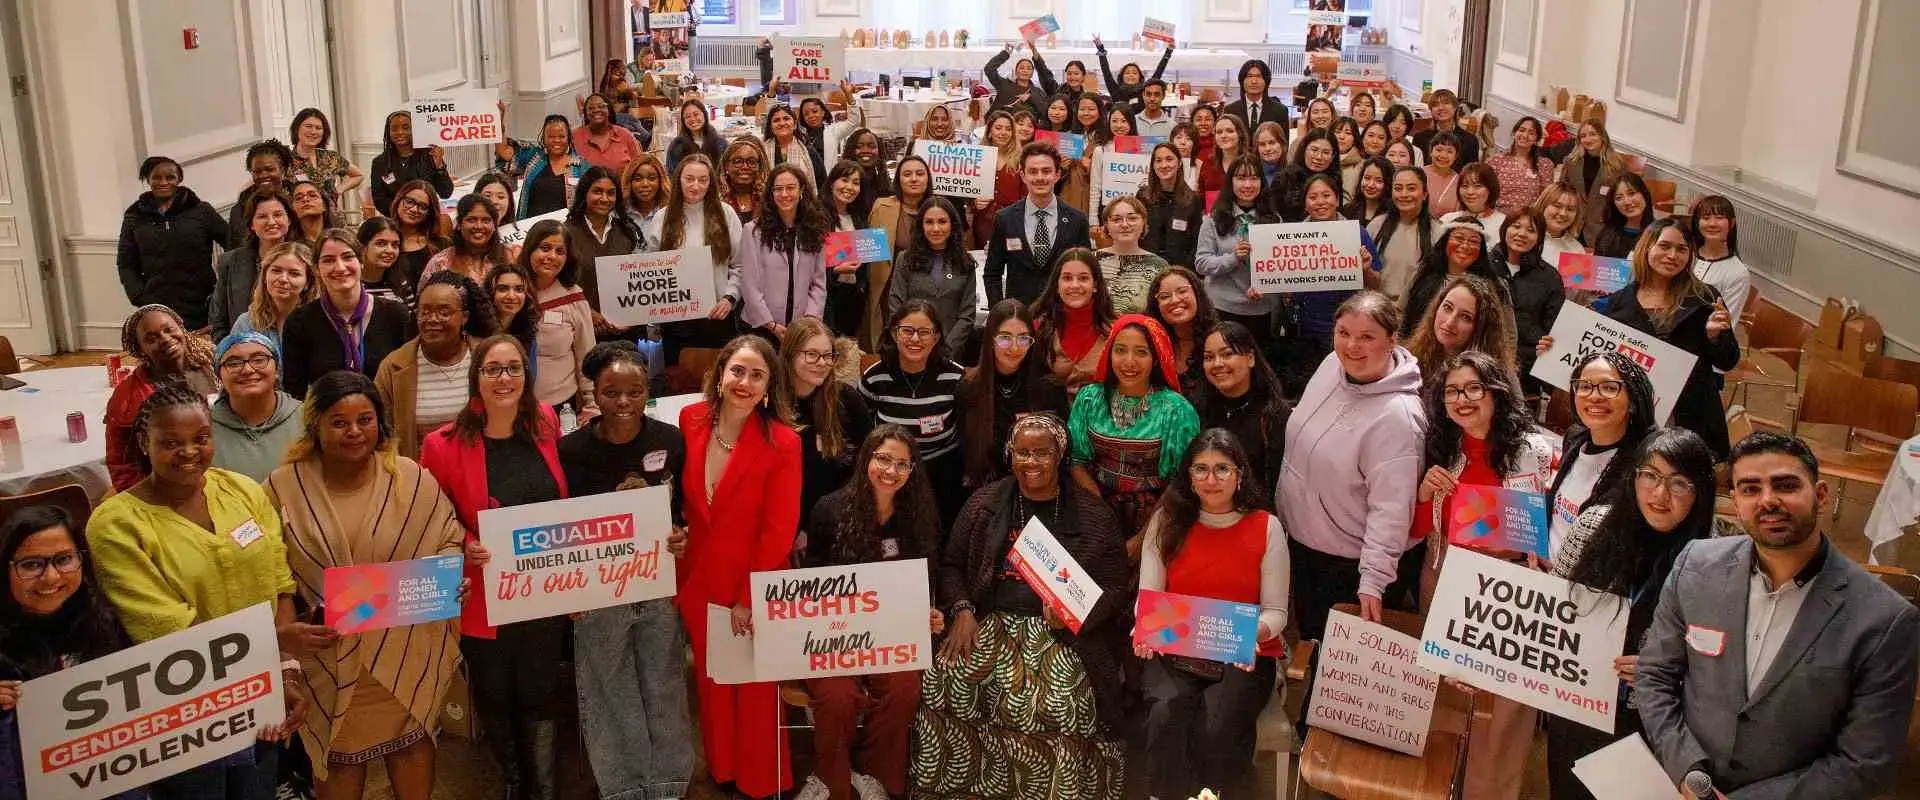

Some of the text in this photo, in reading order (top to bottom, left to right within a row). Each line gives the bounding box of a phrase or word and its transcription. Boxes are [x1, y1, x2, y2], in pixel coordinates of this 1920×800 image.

[792, 48, 823, 58] CARE
[795, 58, 818, 66] FOR
[788, 66, 831, 80] ALL!
[415, 103, 455, 113] SHARE
[439, 113, 495, 126] UNPAID
[440, 125, 496, 141] CARE!
[928, 144, 983, 158] CLIMATE
[928, 153, 982, 177] JUSTICE
[933, 185, 981, 195] ANET TOO!
[935, 176, 971, 187] IT'S OUR
[1293, 231, 1319, 239] WANT
[1272, 244, 1340, 258] DIGITAL
[1256, 255, 1358, 273] REVOLUTION
[630, 268, 673, 279] INVOLVE
[1283, 276, 1317, 284] WORKS
[1318, 275, 1336, 283] FOR
[1338, 274, 1356, 282] ALL!
[627, 277, 678, 292] MORE
[617, 289, 691, 308] WOMEN
[1581, 331, 1617, 352] FOR
[1595, 322, 1617, 337] Keep
[1626, 337, 1649, 350] safe:
[519, 518, 631, 549] EQUALITY
[516, 542, 635, 572] UNDER ALL LAWS
[497, 540, 660, 600] it's our right!
[399, 576, 438, 587] FOR ALL
[399, 584, 437, 594] WOMEN
[765, 572, 858, 602] womens
[767, 590, 880, 620] RIGHTS
[1478, 573, 1578, 624] YOUNG
[830, 621, 849, 630] are
[1199, 615, 1234, 626] FOR ALL
[1199, 622, 1233, 633] WOMEN
[1464, 596, 1581, 656] WOMEN
[1218, 632, 1243, 642] GIRLS
[1332, 622, 1351, 640] IN
[803, 631, 874, 655] human
[810, 643, 918, 671] RIGHTS!
[1446, 619, 1589, 687] LEADERS:
[1328, 648, 1437, 693] WITH ALL YOUNG
[1423, 640, 1609, 715] the change we want!
[62, 632, 250, 730] STOP
[1321, 665, 1431, 711] WOMEN AND GIRLS
[1320, 686, 1405, 720] MISSING IN THIS
[49, 679, 265, 767] GENDER-BASED
[1315, 705, 1421, 745] CONVERSATION
[68, 708, 256, 789] VIOLENCE!
